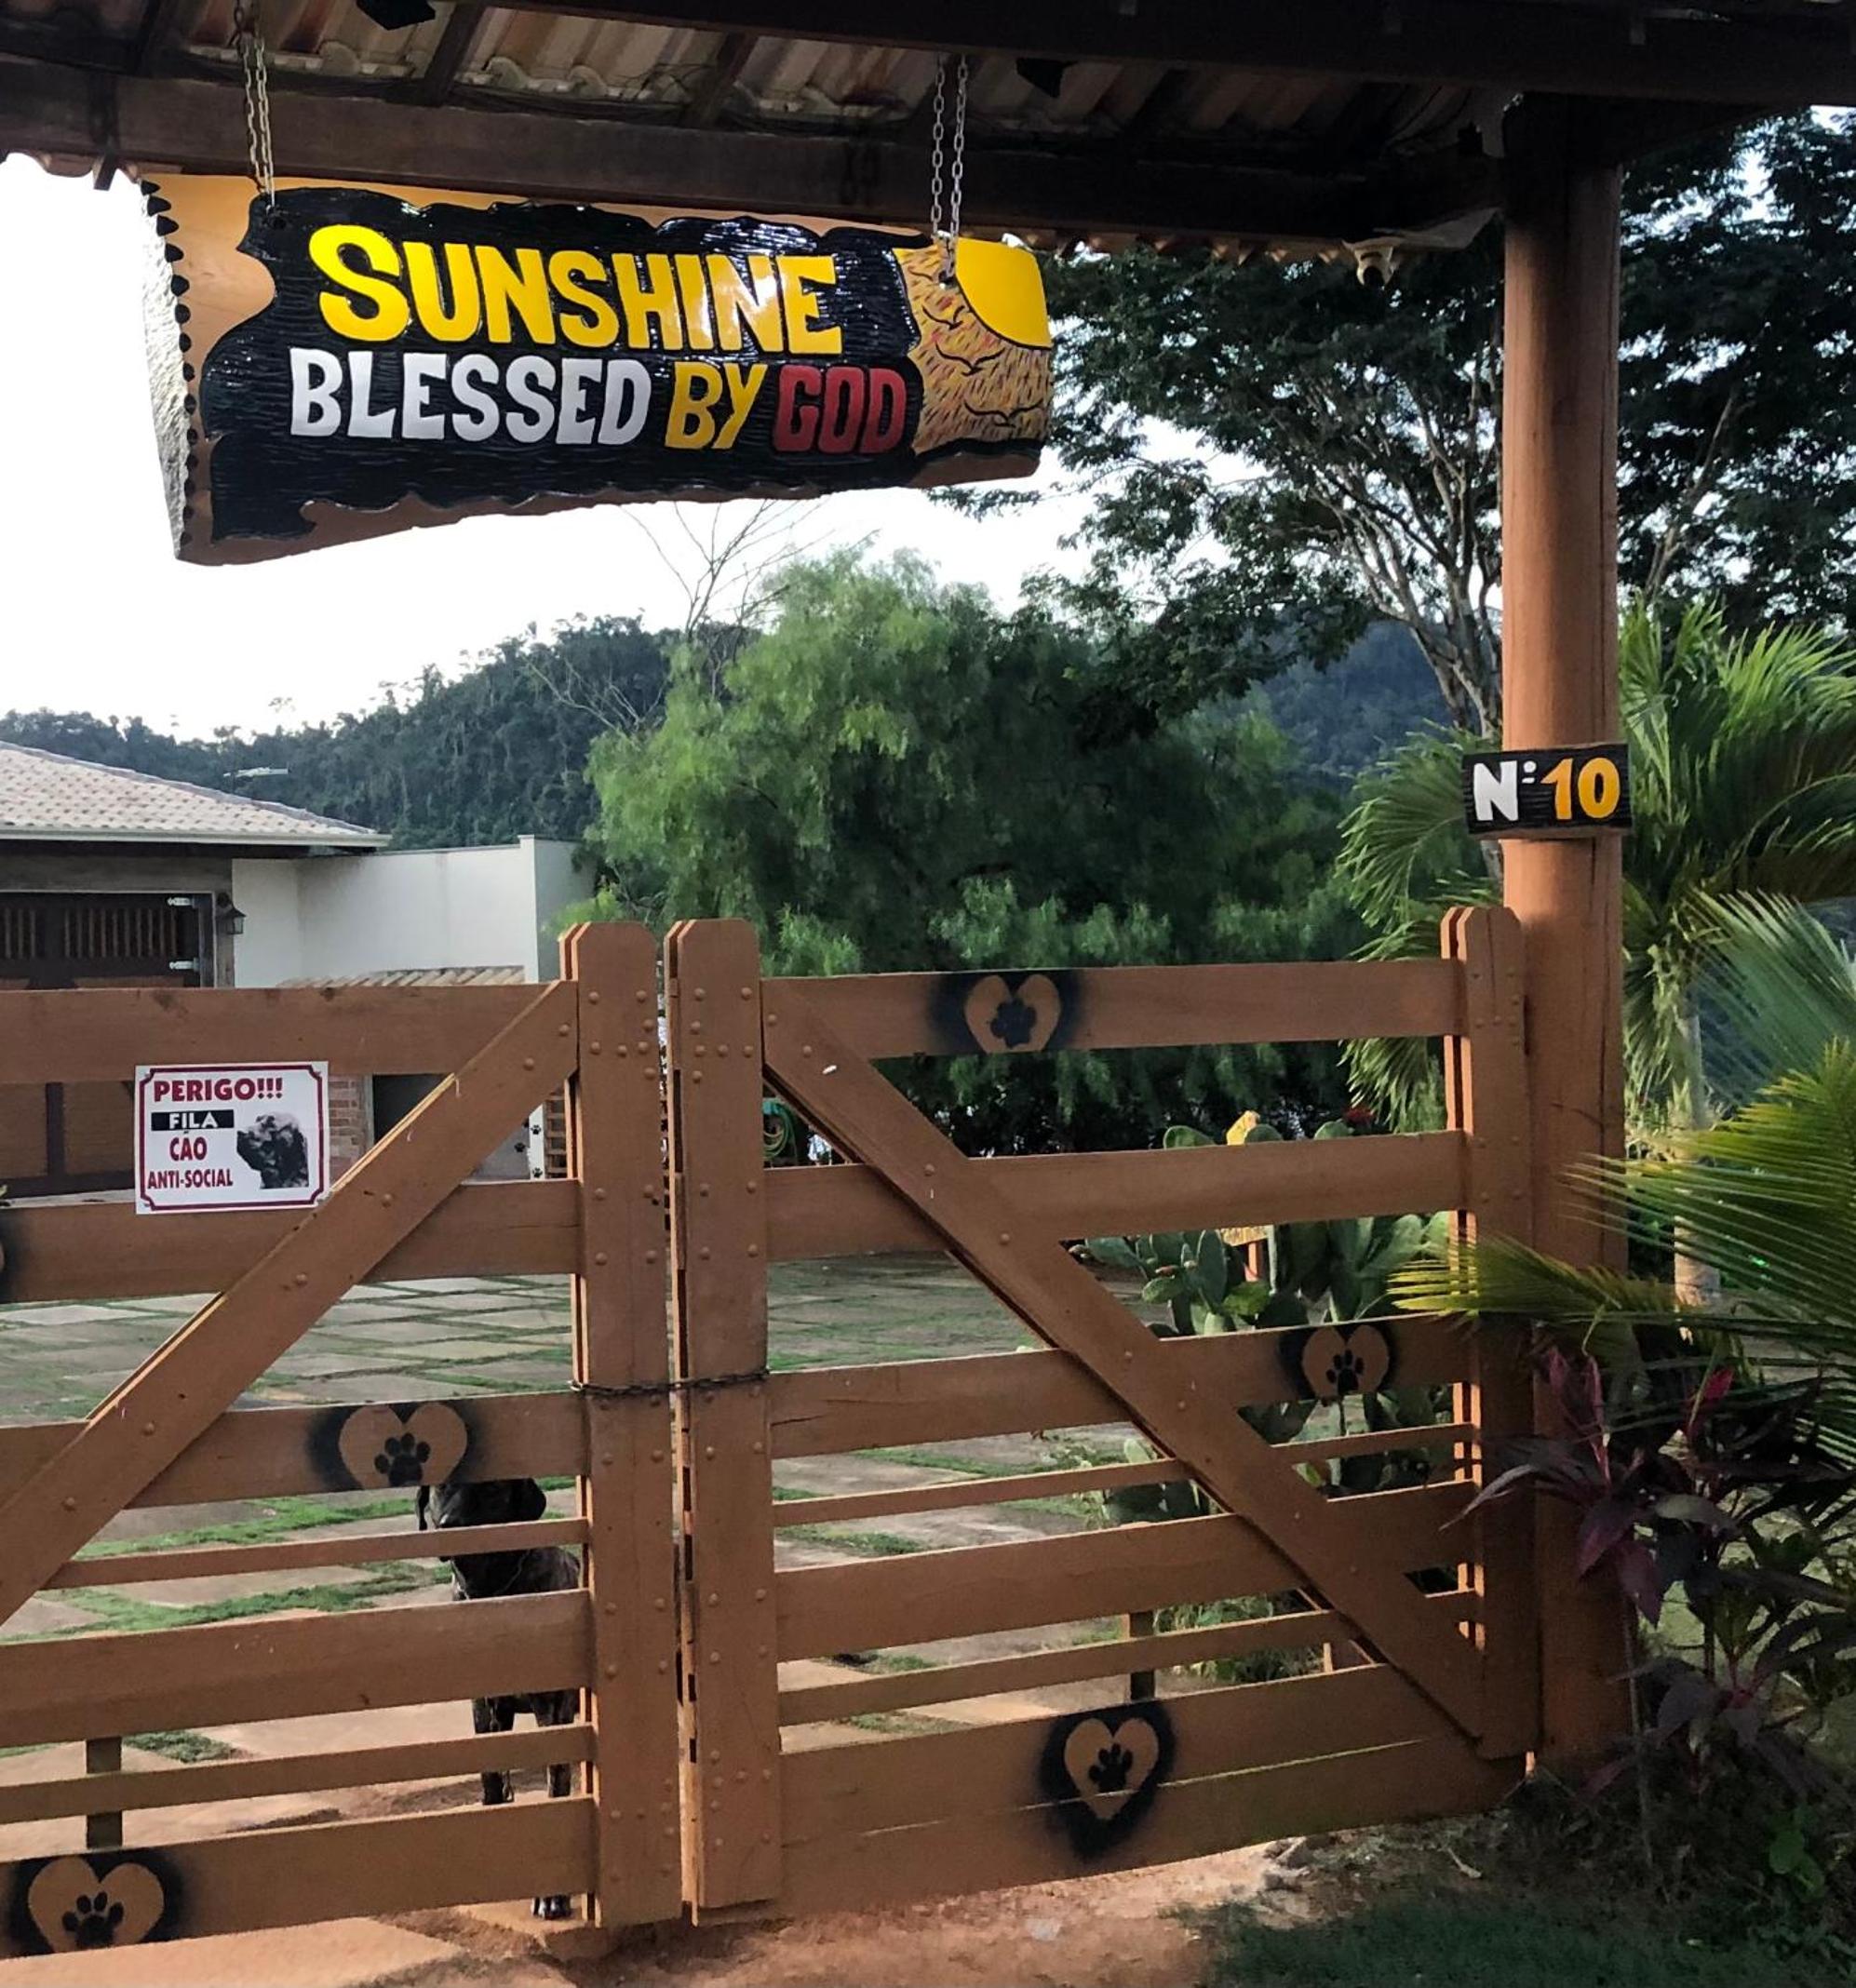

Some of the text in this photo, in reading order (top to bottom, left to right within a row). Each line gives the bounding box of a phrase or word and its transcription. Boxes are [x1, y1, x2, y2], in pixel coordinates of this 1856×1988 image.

[309, 224, 843, 355] SUNSHINE
[290, 349, 908, 452] BLESSED BY GOD
[1540, 757, 1621, 819] 10
[154, 1077, 283, 1102] PERIGO!!!
[168, 1111, 219, 1129] FILA
[169, 1130, 208, 1162] CÃO
[147, 1169, 233, 1189] ANTI-SOCIAL
